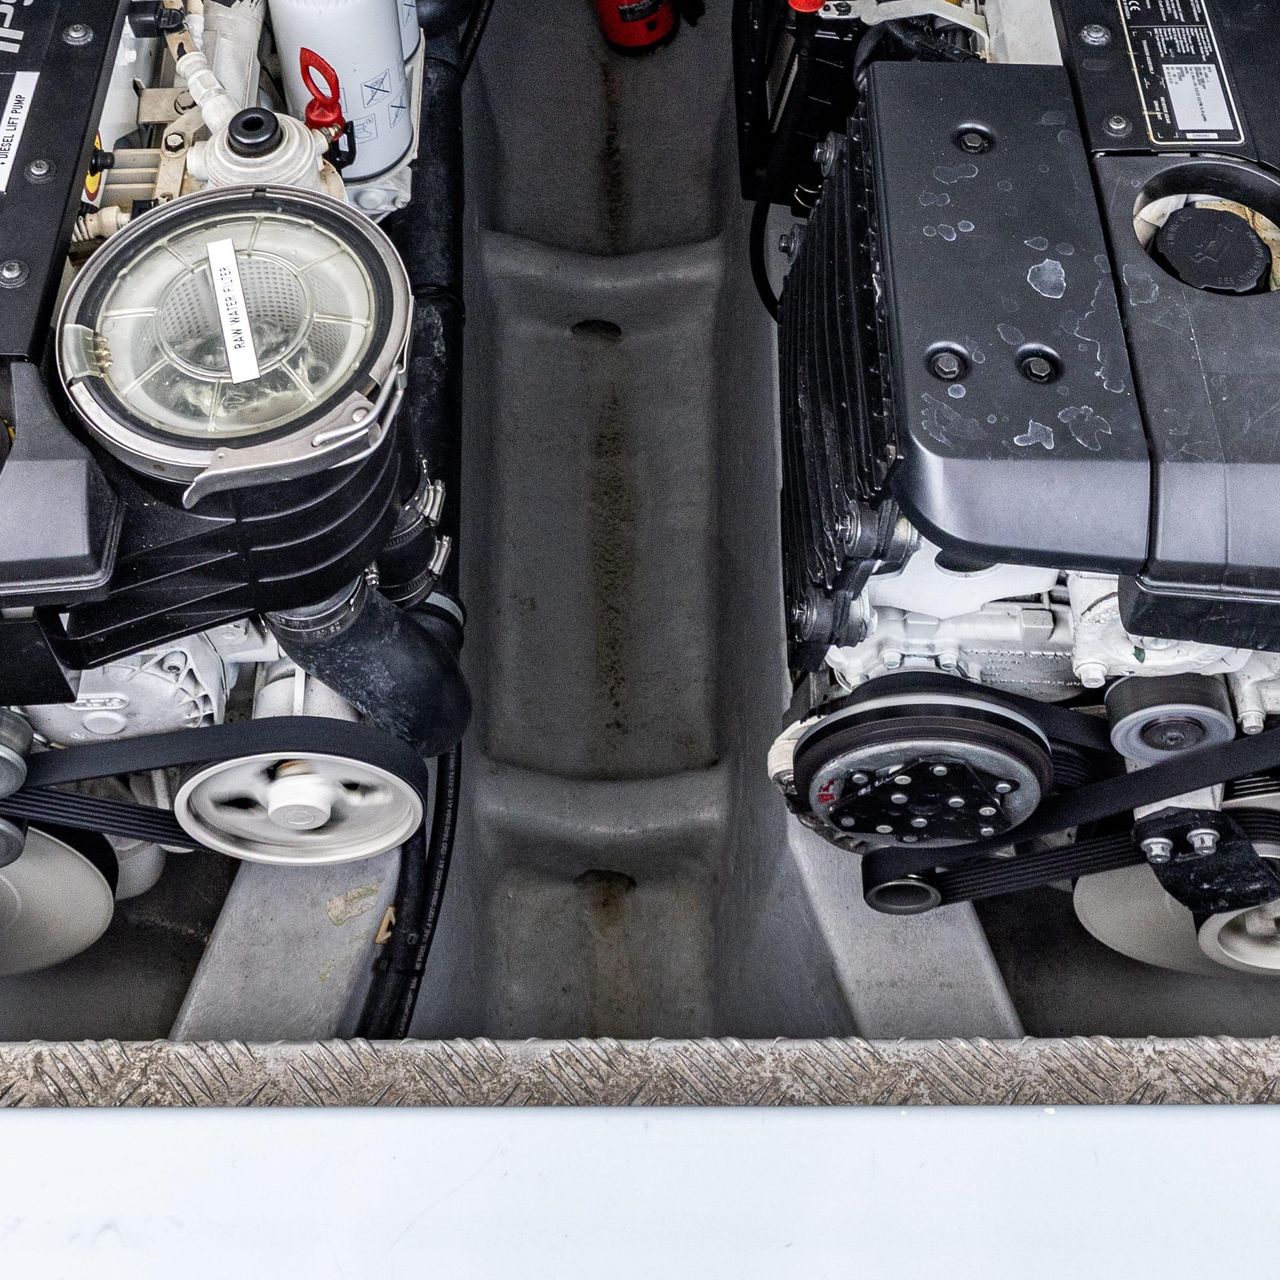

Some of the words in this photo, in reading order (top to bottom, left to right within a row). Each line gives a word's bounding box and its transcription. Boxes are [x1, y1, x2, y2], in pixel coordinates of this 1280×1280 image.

[11, 94, 26, 114] PUMP
[5, 117, 19, 131] LIFT
[219, 266, 234, 293] FILTER
[225, 296, 240, 326] WATER
[231, 328, 246, 349] RAW
